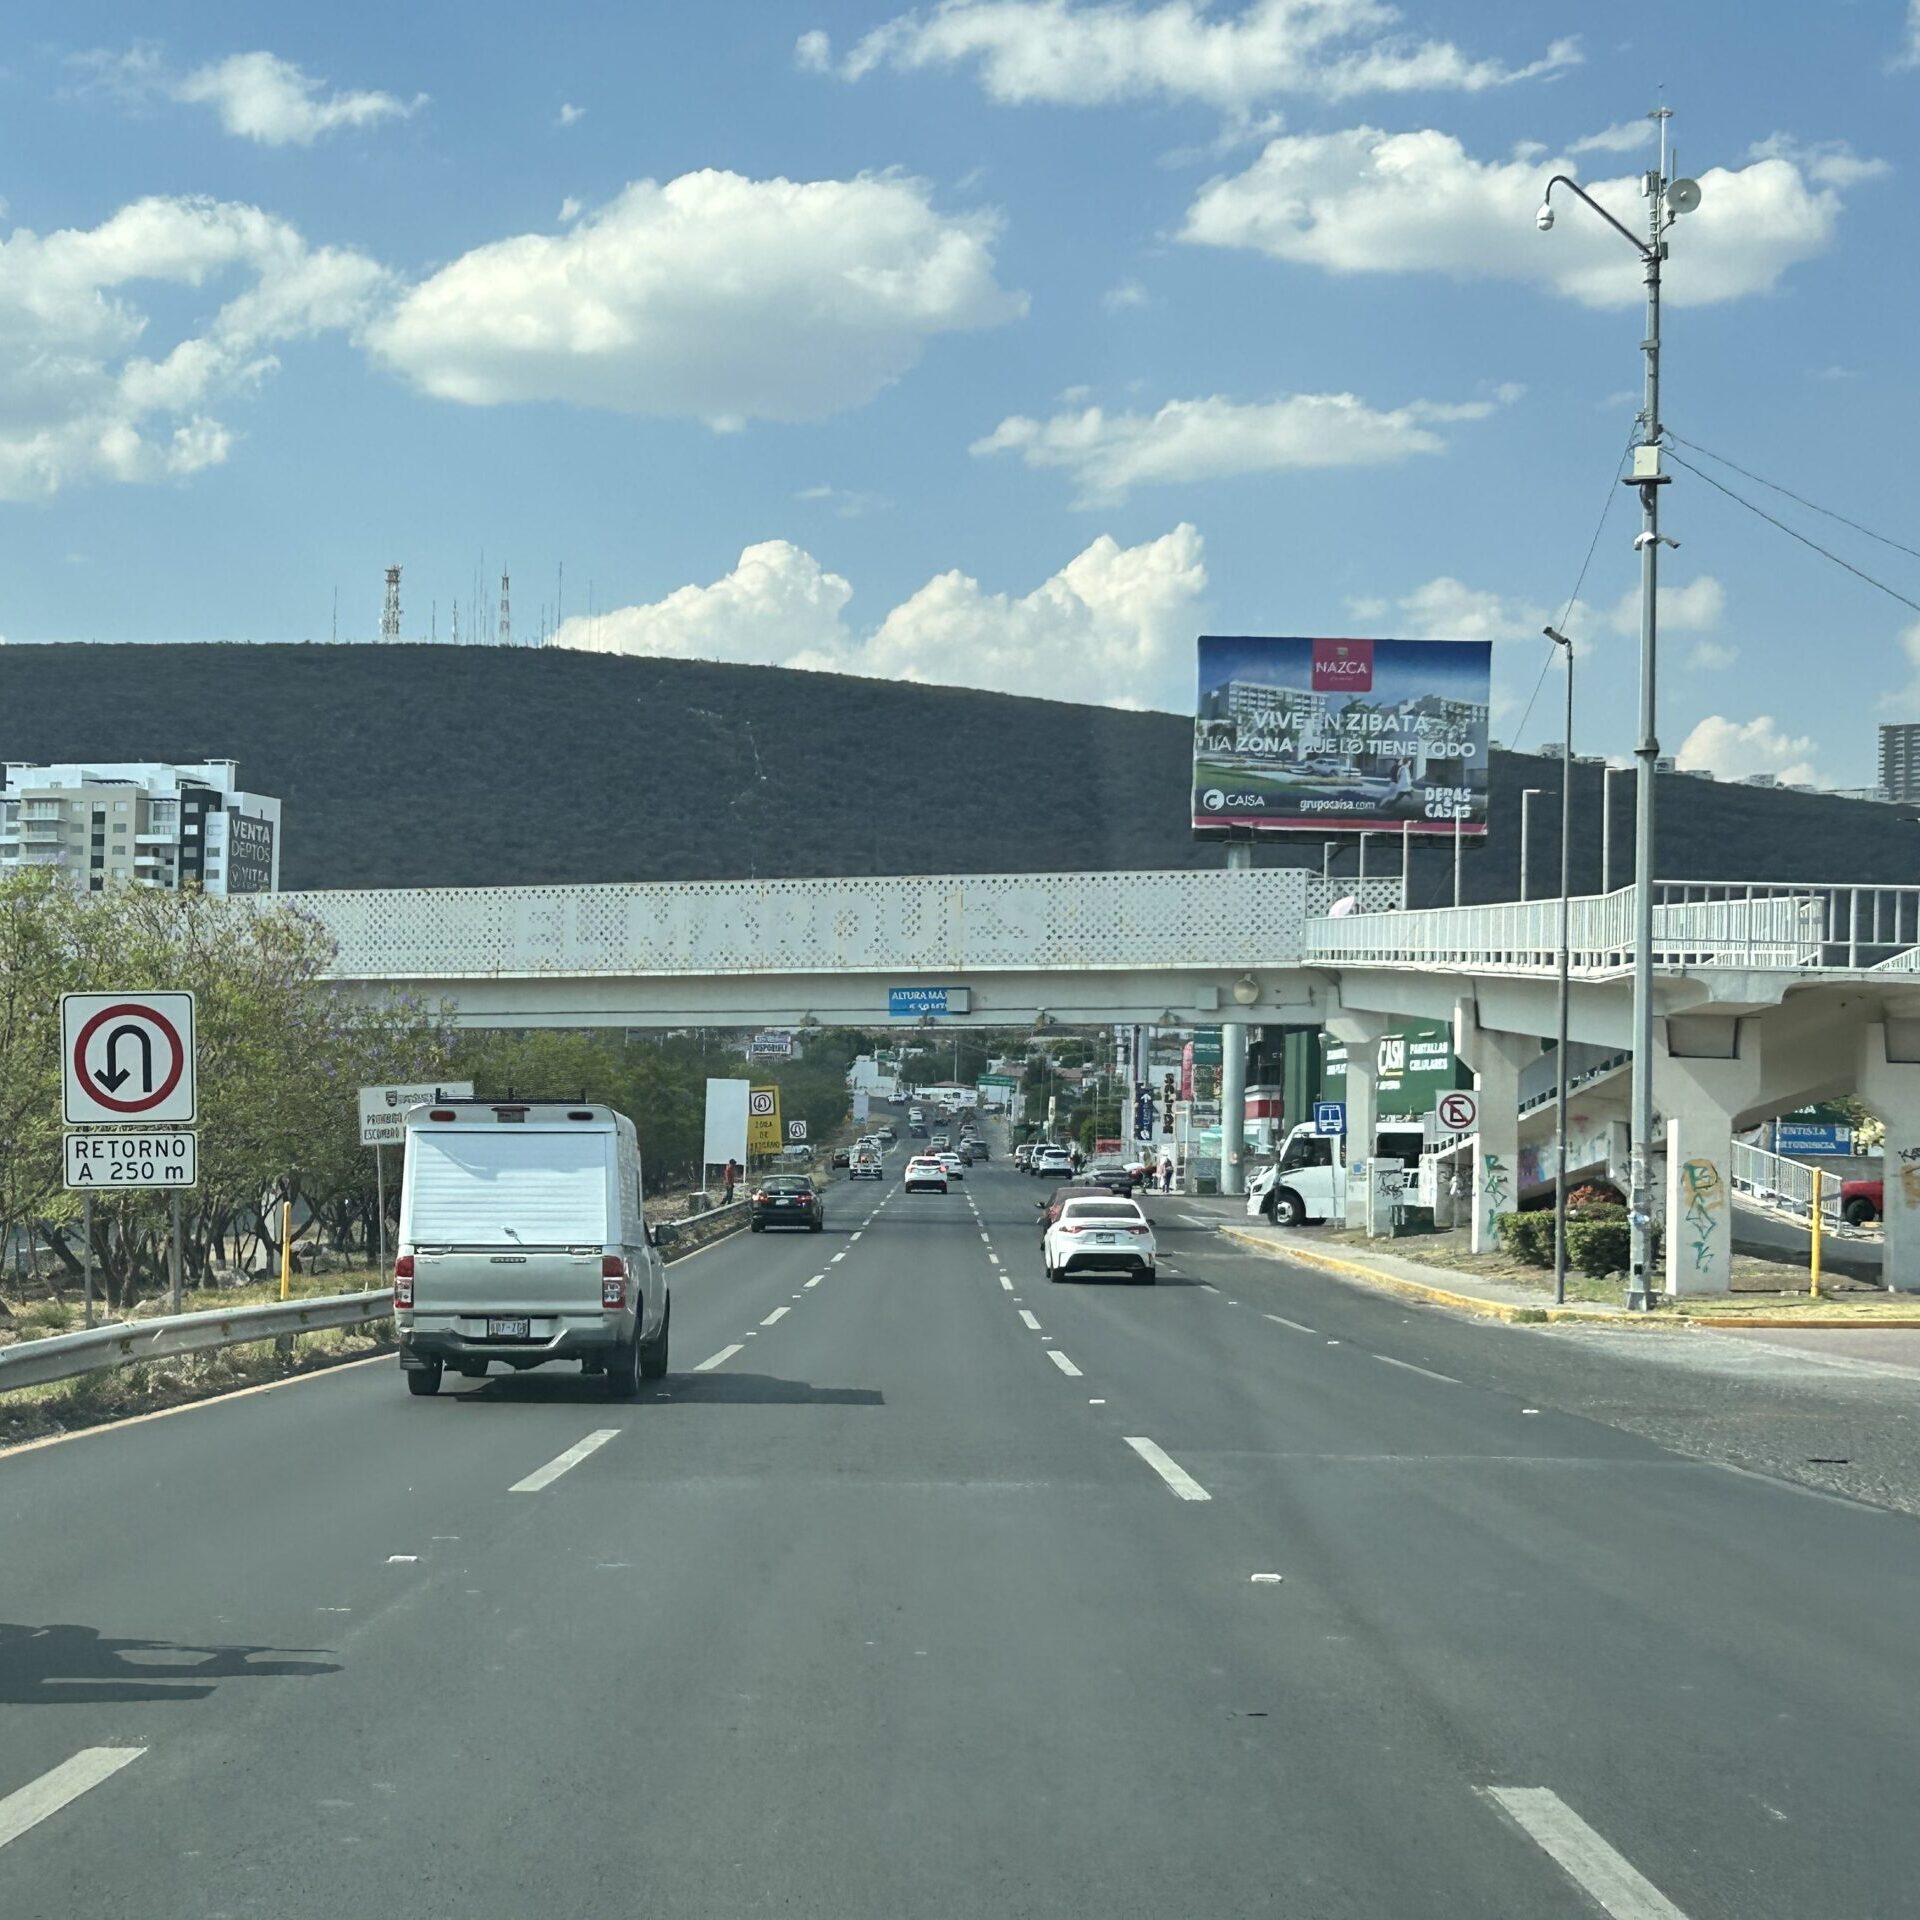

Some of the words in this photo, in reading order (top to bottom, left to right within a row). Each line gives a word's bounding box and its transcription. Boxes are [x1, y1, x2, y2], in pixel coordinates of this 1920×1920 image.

[1315, 661, 1367, 674] NAZCA
[1254, 711, 1304, 730] VIVE
[1235, 737, 1293, 753] ZONA
[1340, 739, 1364, 755] LO
[1366, 739, 1418, 756] TIENE
[1423, 741, 1476, 757] TODO
[1226, 794, 1265, 807] CAISA
[1424, 787, 1471, 802] DEPAS
[1299, 798, 1376, 812] grupocaisa.com
[232, 819, 271, 844] VENTA
[231, 841, 271, 863] DEPTOS
[891, 991, 927, 1000] ALTURA
[75, 1139, 186, 1159] RETORNO
[78, 1162, 94, 1181] A
[110, 1161, 155, 1180] 250
[165, 1165, 184, 1180] m
